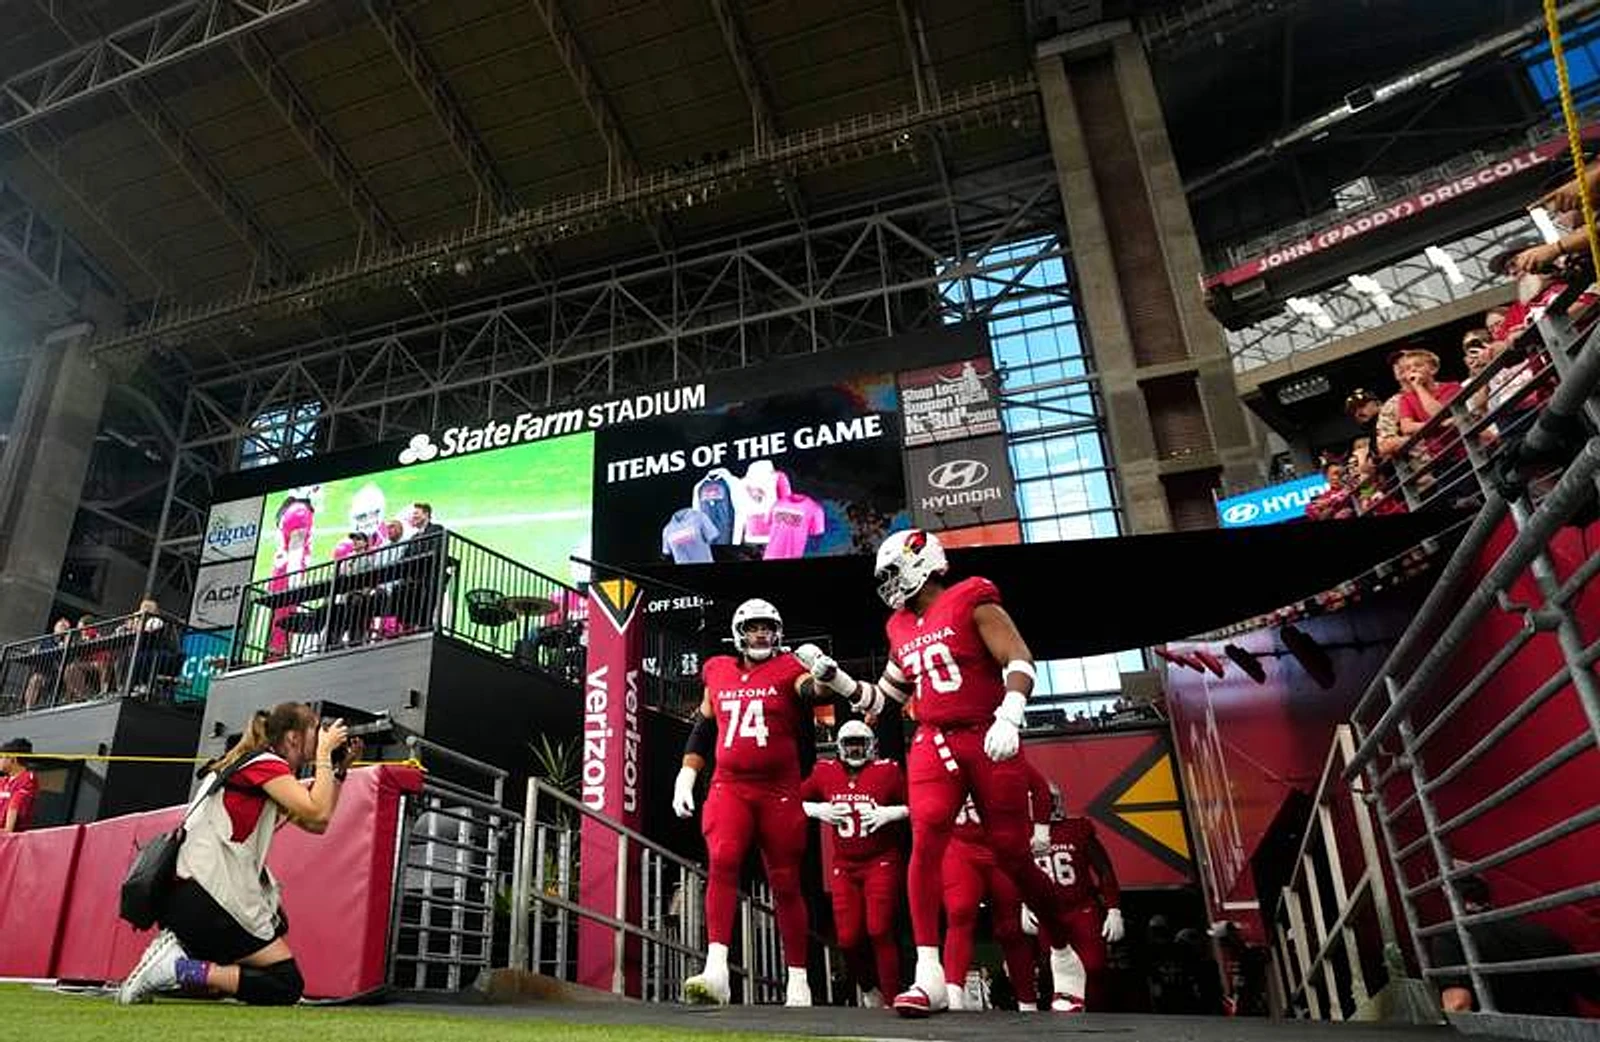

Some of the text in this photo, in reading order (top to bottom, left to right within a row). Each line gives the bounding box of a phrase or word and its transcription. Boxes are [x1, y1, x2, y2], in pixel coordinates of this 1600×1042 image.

[1257, 151, 1548, 271] JOHN (PADDY) DRISCOLL
[587, 384, 706, 428] STADIUM
[607, 450, 686, 484] ITEMS
[692, 442, 728, 468] OF
[733, 431, 787, 461] THE
[793, 415, 883, 450] GAME
[921, 487, 1001, 510] HYUNDAI
[207, 523, 257, 546] cigna
[647, 600, 671, 613] OFF
[898, 626, 957, 661] ARIZONA
[718, 686, 778, 700] ARIZONA
[901, 641, 964, 700] 70
[582, 665, 613, 811] verizon
[623, 669, 642, 812] verizon
[720, 699, 769, 748] 74
